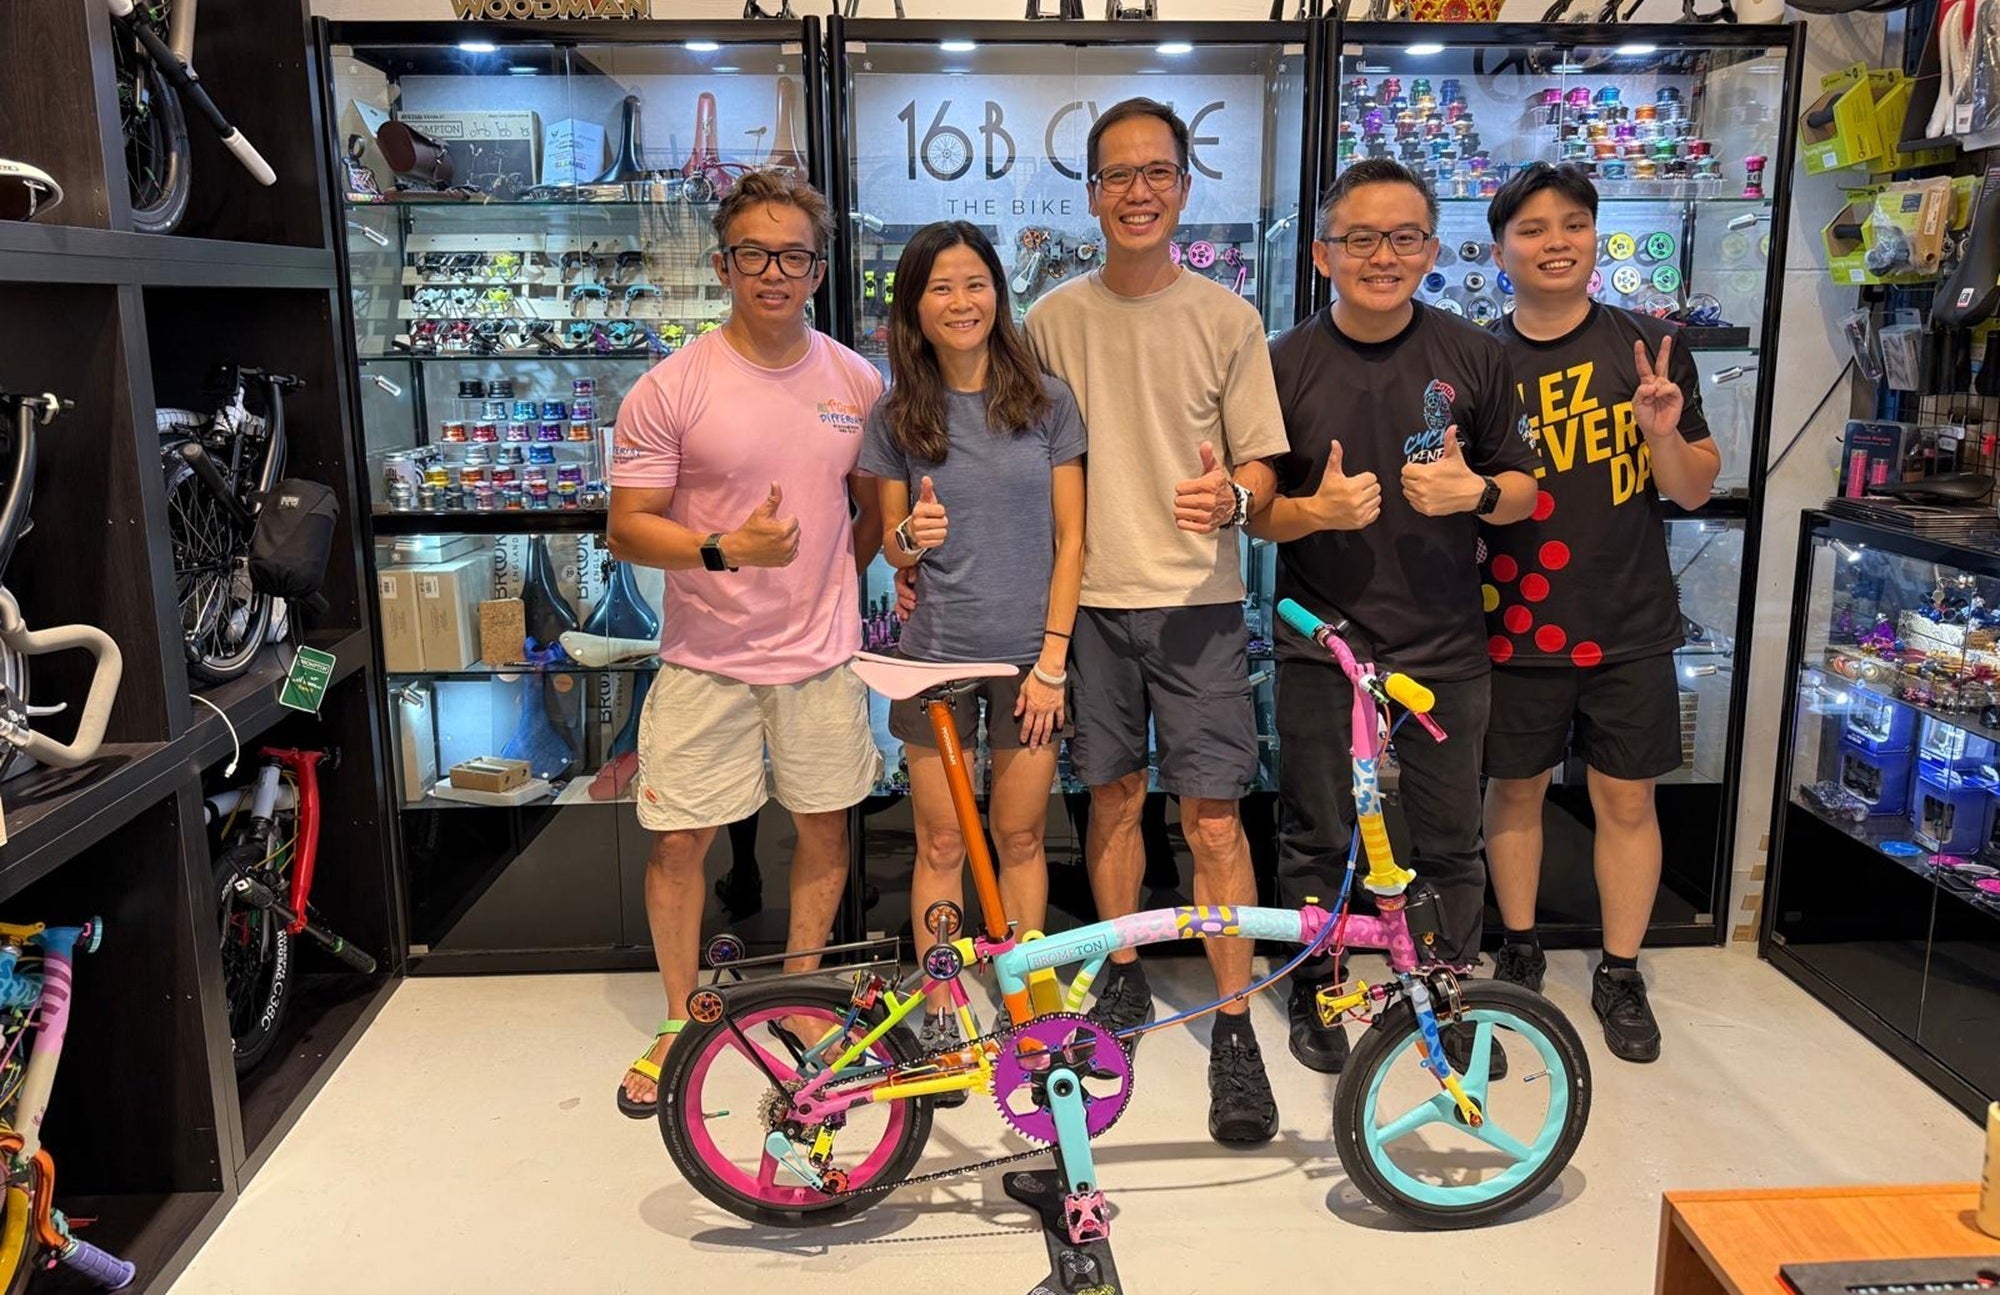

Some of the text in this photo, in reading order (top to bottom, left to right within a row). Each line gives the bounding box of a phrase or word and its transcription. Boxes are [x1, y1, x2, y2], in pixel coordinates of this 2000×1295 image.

[451, 0, 649, 18] WOODMAN
[898, 99, 1016, 181] 16B
[947, 199, 996, 215] THE
[1012, 199, 1072, 215] BIKE
[1610, 443, 1651, 506] DA
[494, 535, 508, 600] BROOK
[577, 534, 589, 600] BROOK
[600, 666, 612, 723] BROO
[1032, 939, 1104, 968] BROMPTON
[260, 981, 284, 1032] C38C
